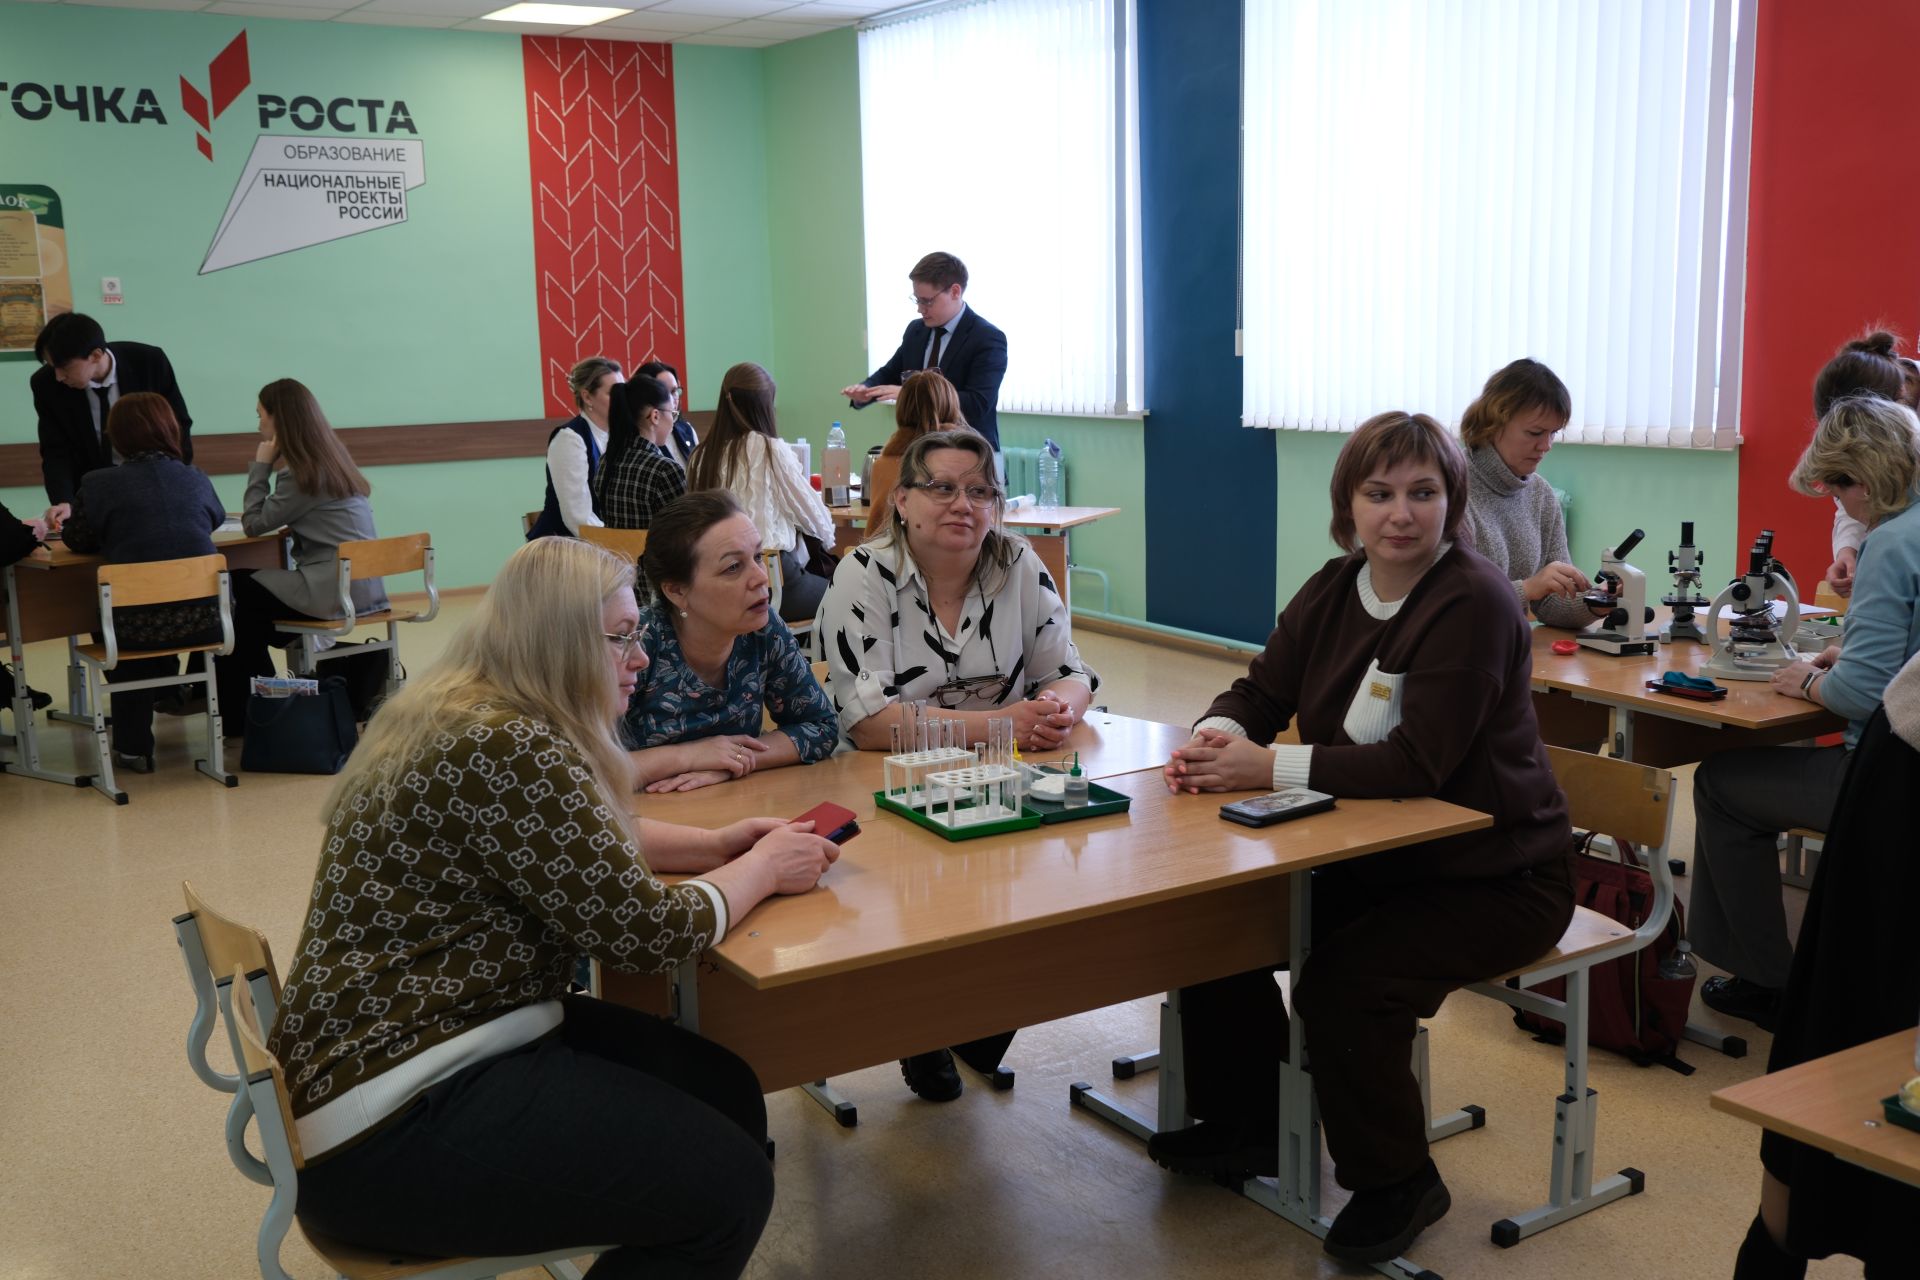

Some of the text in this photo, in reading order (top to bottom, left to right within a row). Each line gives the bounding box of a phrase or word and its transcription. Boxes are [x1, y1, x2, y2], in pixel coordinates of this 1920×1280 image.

[257, 94, 418, 134] РОСТА
[284, 145, 407, 162] ОБРАЗОВАНИЕ
[264, 174, 402, 190] НАЦИОНАЛЬНЫЕ
[327, 191, 402, 204] ПРОЕКТЫ
[339, 206, 404, 219] РОССИИ
